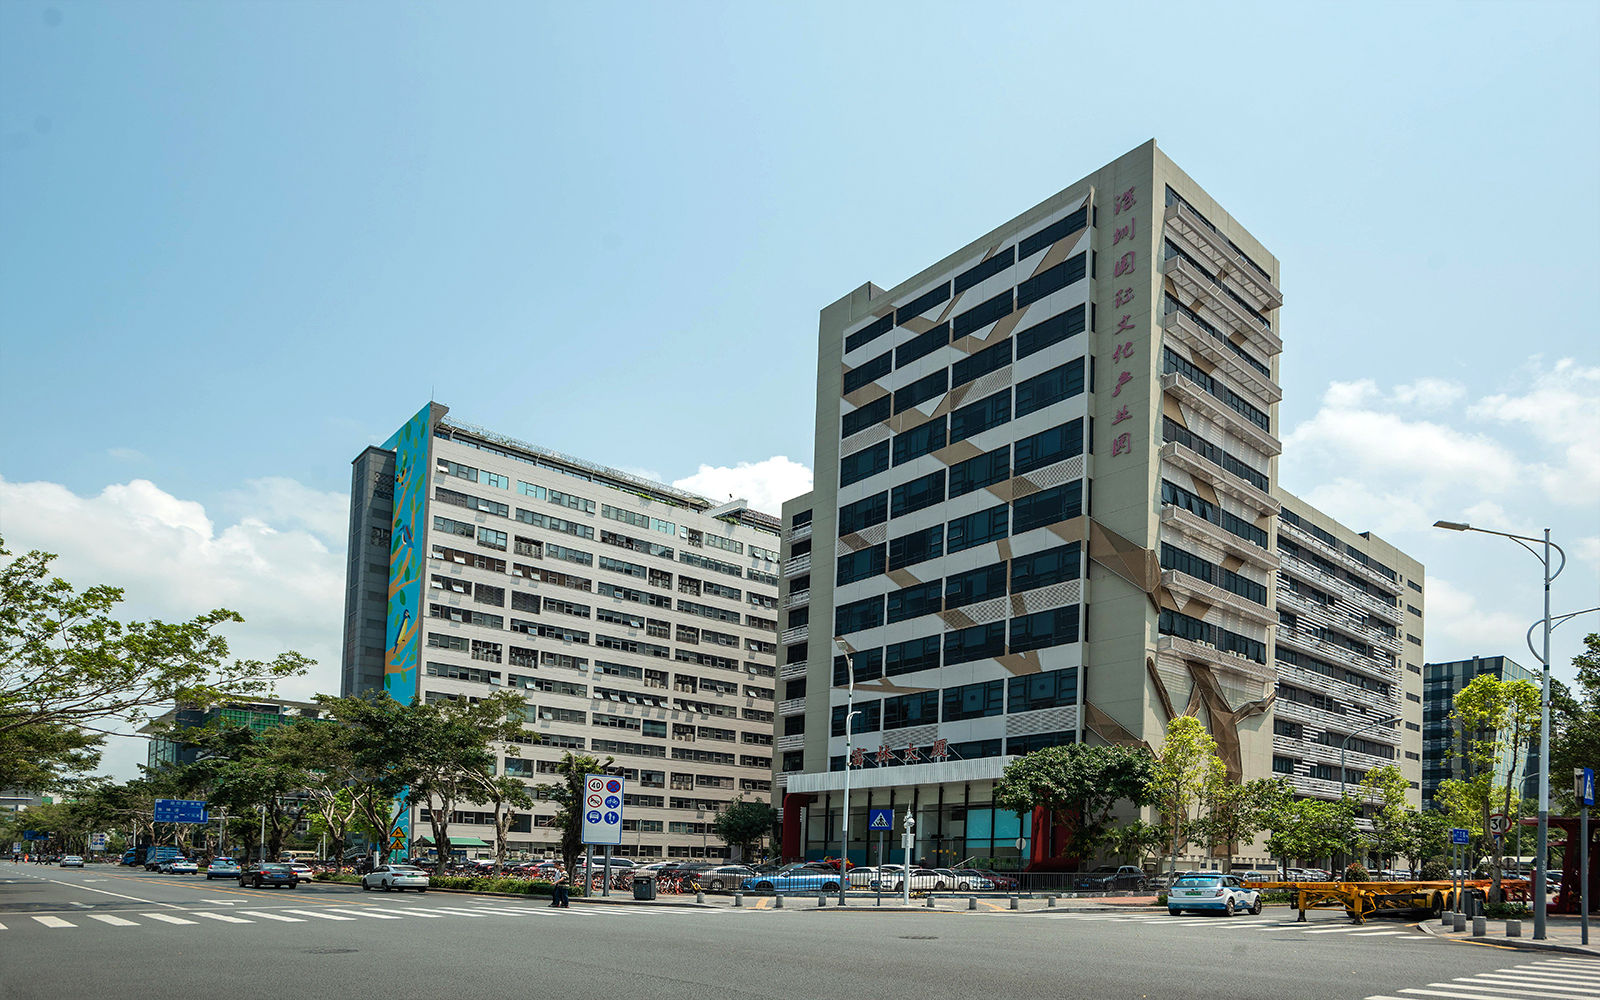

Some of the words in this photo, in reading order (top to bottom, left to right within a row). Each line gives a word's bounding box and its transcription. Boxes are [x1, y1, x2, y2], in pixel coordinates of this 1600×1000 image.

[851, 738, 951, 766] 富林大厦
[591, 781, 601, 789] 40
